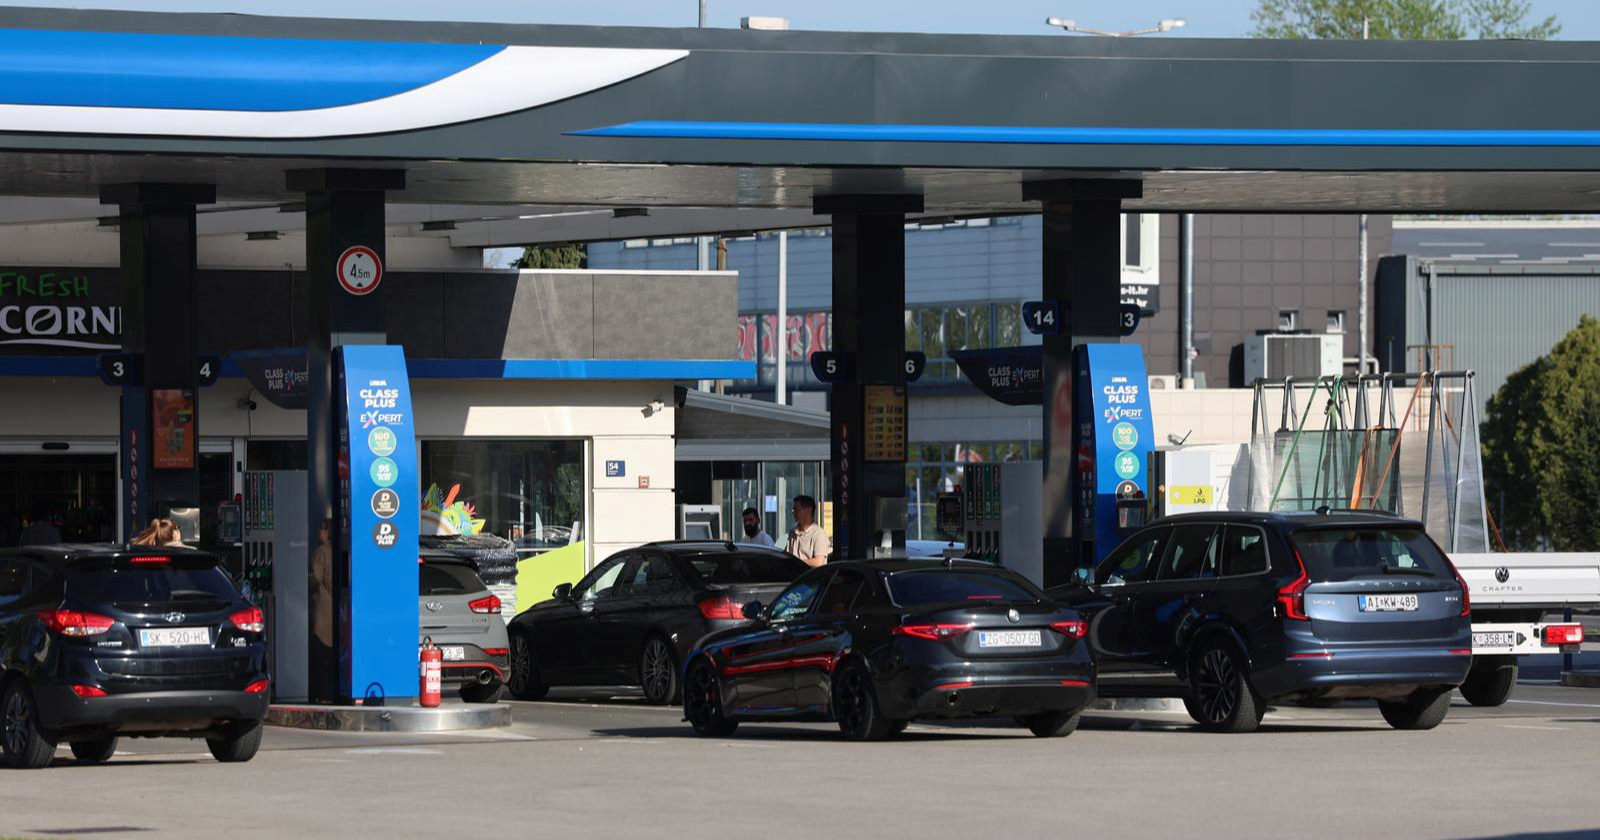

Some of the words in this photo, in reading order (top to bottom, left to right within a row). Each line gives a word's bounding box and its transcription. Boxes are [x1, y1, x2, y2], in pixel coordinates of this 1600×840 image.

[350, 263, 371, 280] 4,5m
[0, 272, 89, 297] FRESH
[0, 305, 122, 335] CORN
[1033, 310, 1055, 326] 14
[113, 362, 124, 377] 3
[200, 362, 211, 378] 4
[826, 359, 837, 374] 5
[905, 359, 916, 374] 6
[988, 366, 1011, 377] CLASS
[264, 368, 284, 380] CLASS
[268, 380, 284, 390] PLUS
[991, 377, 1010, 387] PLUS
[359, 389, 399, 399] CLASS
[1103, 385, 1139, 395] CLASS
[364, 399, 396, 408] PLUS
[1108, 395, 1136, 404] PLUS
[373, 432, 390, 441] 100
[1117, 427, 1133, 436] 100
[609, 462, 619, 470] 54
[1121, 457, 1133, 466] 95
[377, 464, 391, 473] 95
[1124, 485, 1133, 493] D
[381, 493, 390, 502] D
[379, 523, 392, 535] D
[1368, 596, 1381, 608] AI
[149, 633, 161, 643] SK
